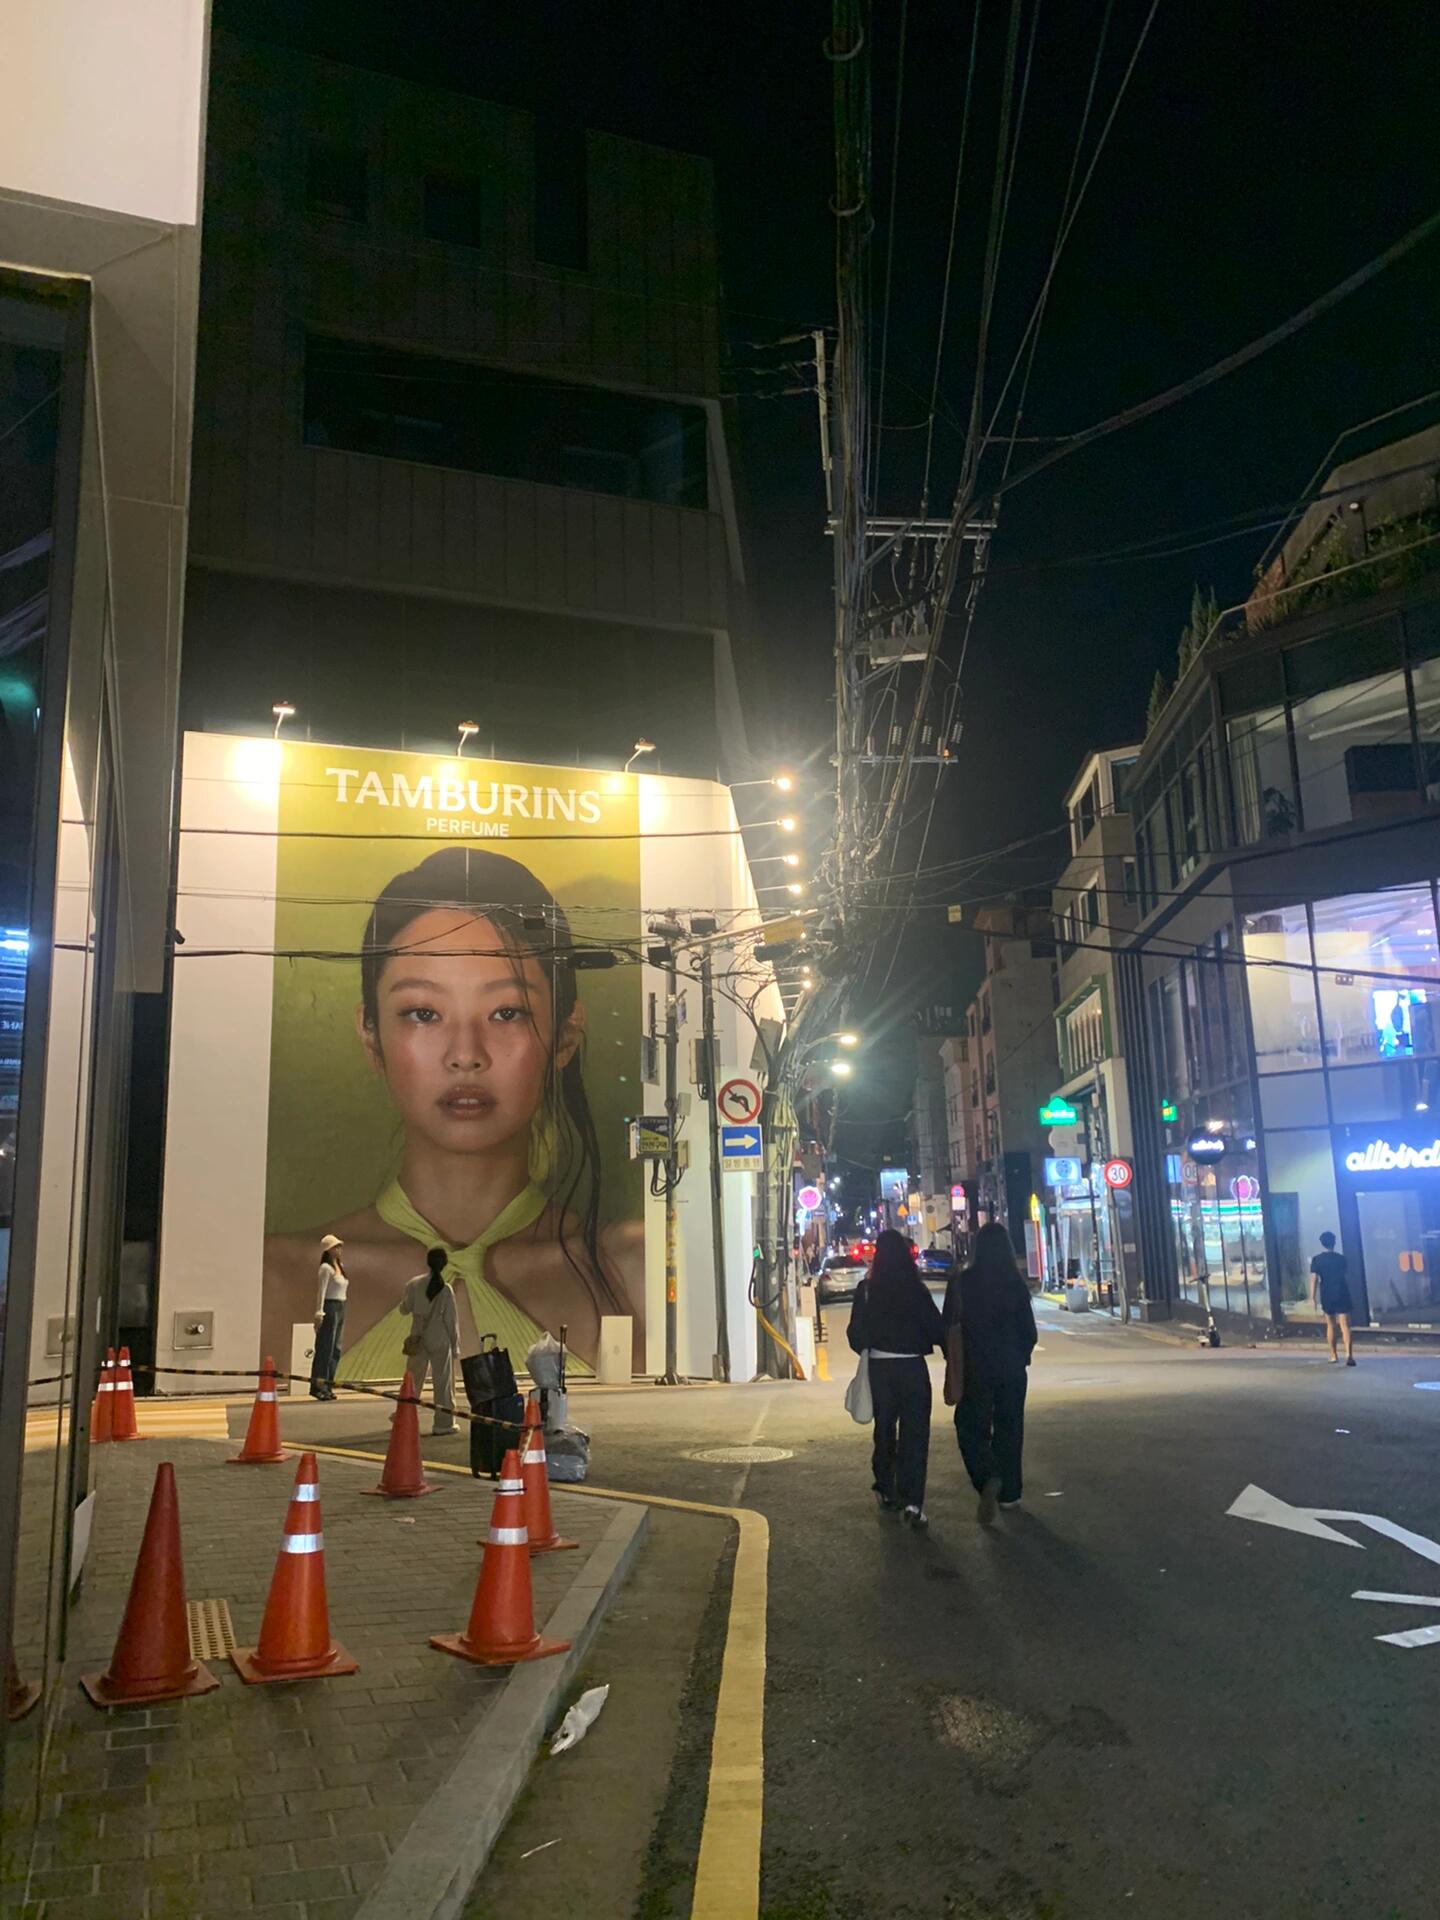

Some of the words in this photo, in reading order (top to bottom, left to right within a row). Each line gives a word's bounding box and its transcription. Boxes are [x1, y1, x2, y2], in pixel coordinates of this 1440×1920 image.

[325, 767, 602, 824] TAMBURINS
[426, 817, 510, 838] PERFUME
[1111, 1166, 1126, 1181] 30
